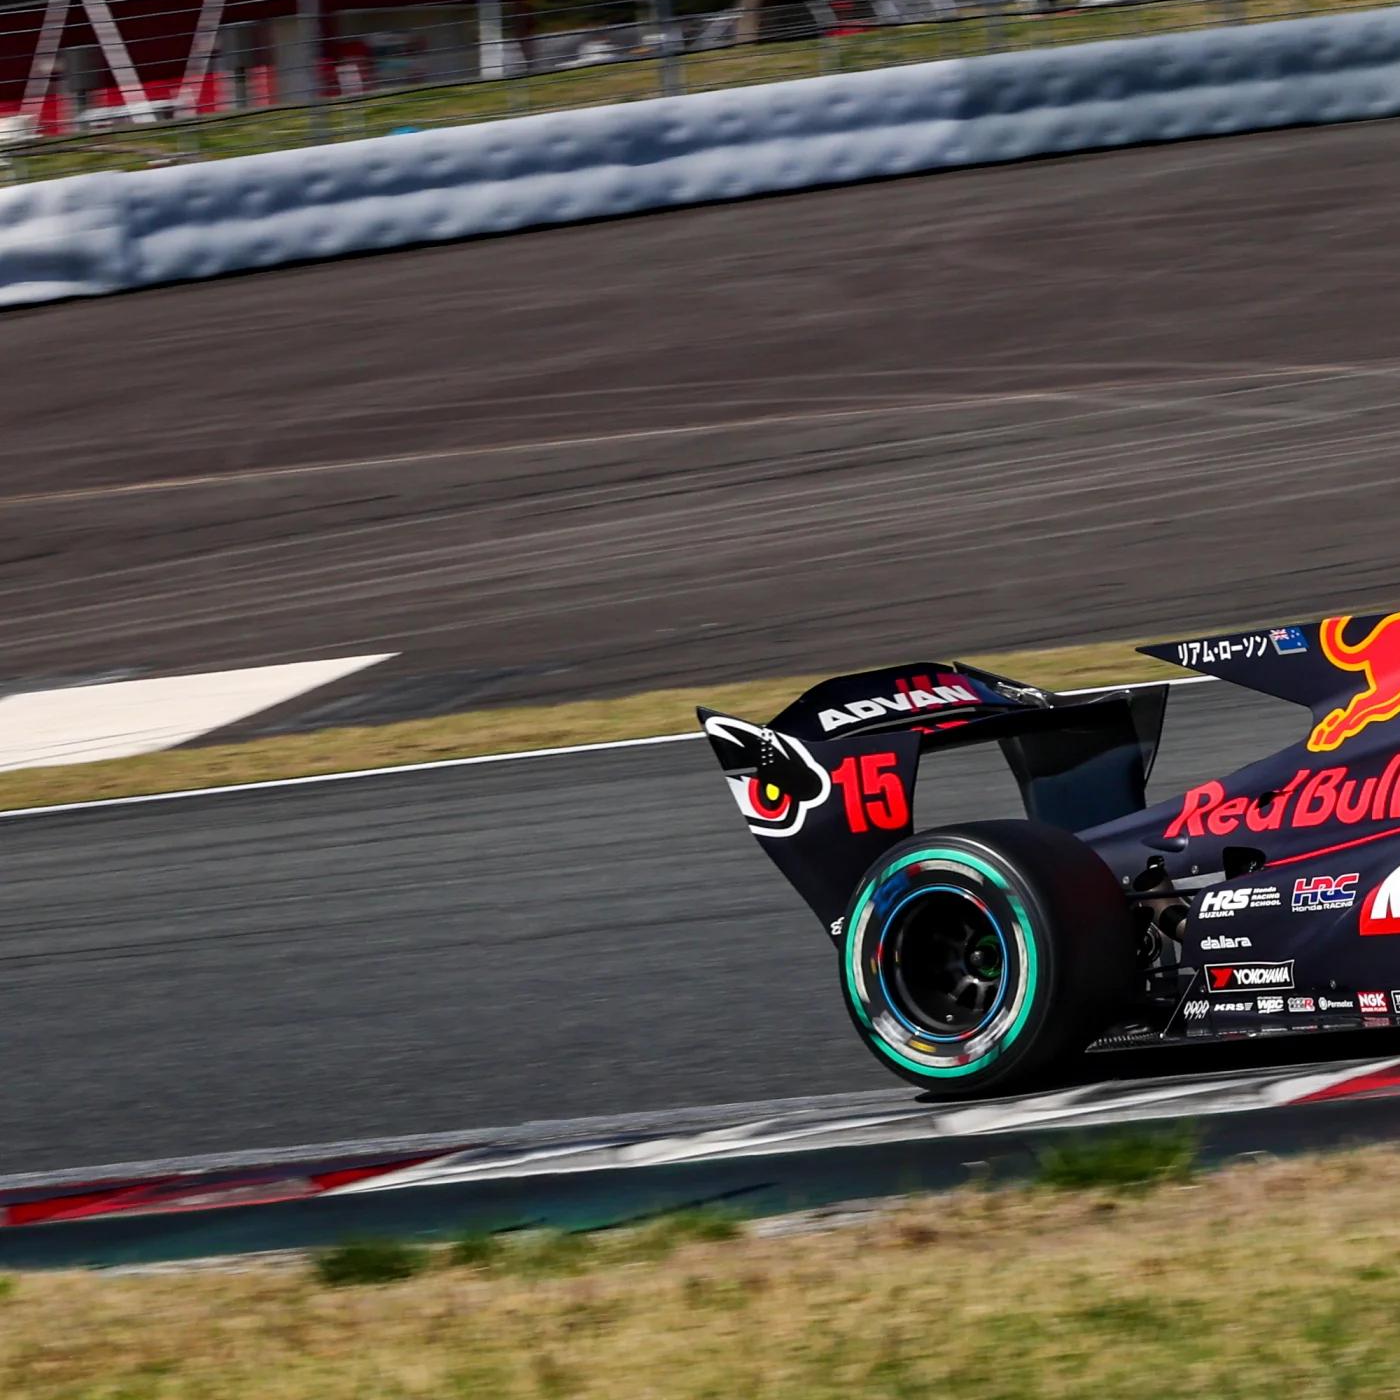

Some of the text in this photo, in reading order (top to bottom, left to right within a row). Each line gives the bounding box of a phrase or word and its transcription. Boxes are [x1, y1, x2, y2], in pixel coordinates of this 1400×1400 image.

[1178, 635, 1267, 666] リアム・ローソン
[817, 685, 978, 732] ADVAN
[830, 752, 909, 833] 15
[1164, 770, 1310, 838] Red
[1200, 888, 1252, 912] HRS
[1291, 872, 1359, 906] HRC
[1198, 910, 1235, 919] SUZUKA
[1200, 935, 1252, 950] dallara
[1233, 966, 1290, 985] YOKOHAMA
[1358, 992, 1386, 1007] NGK
